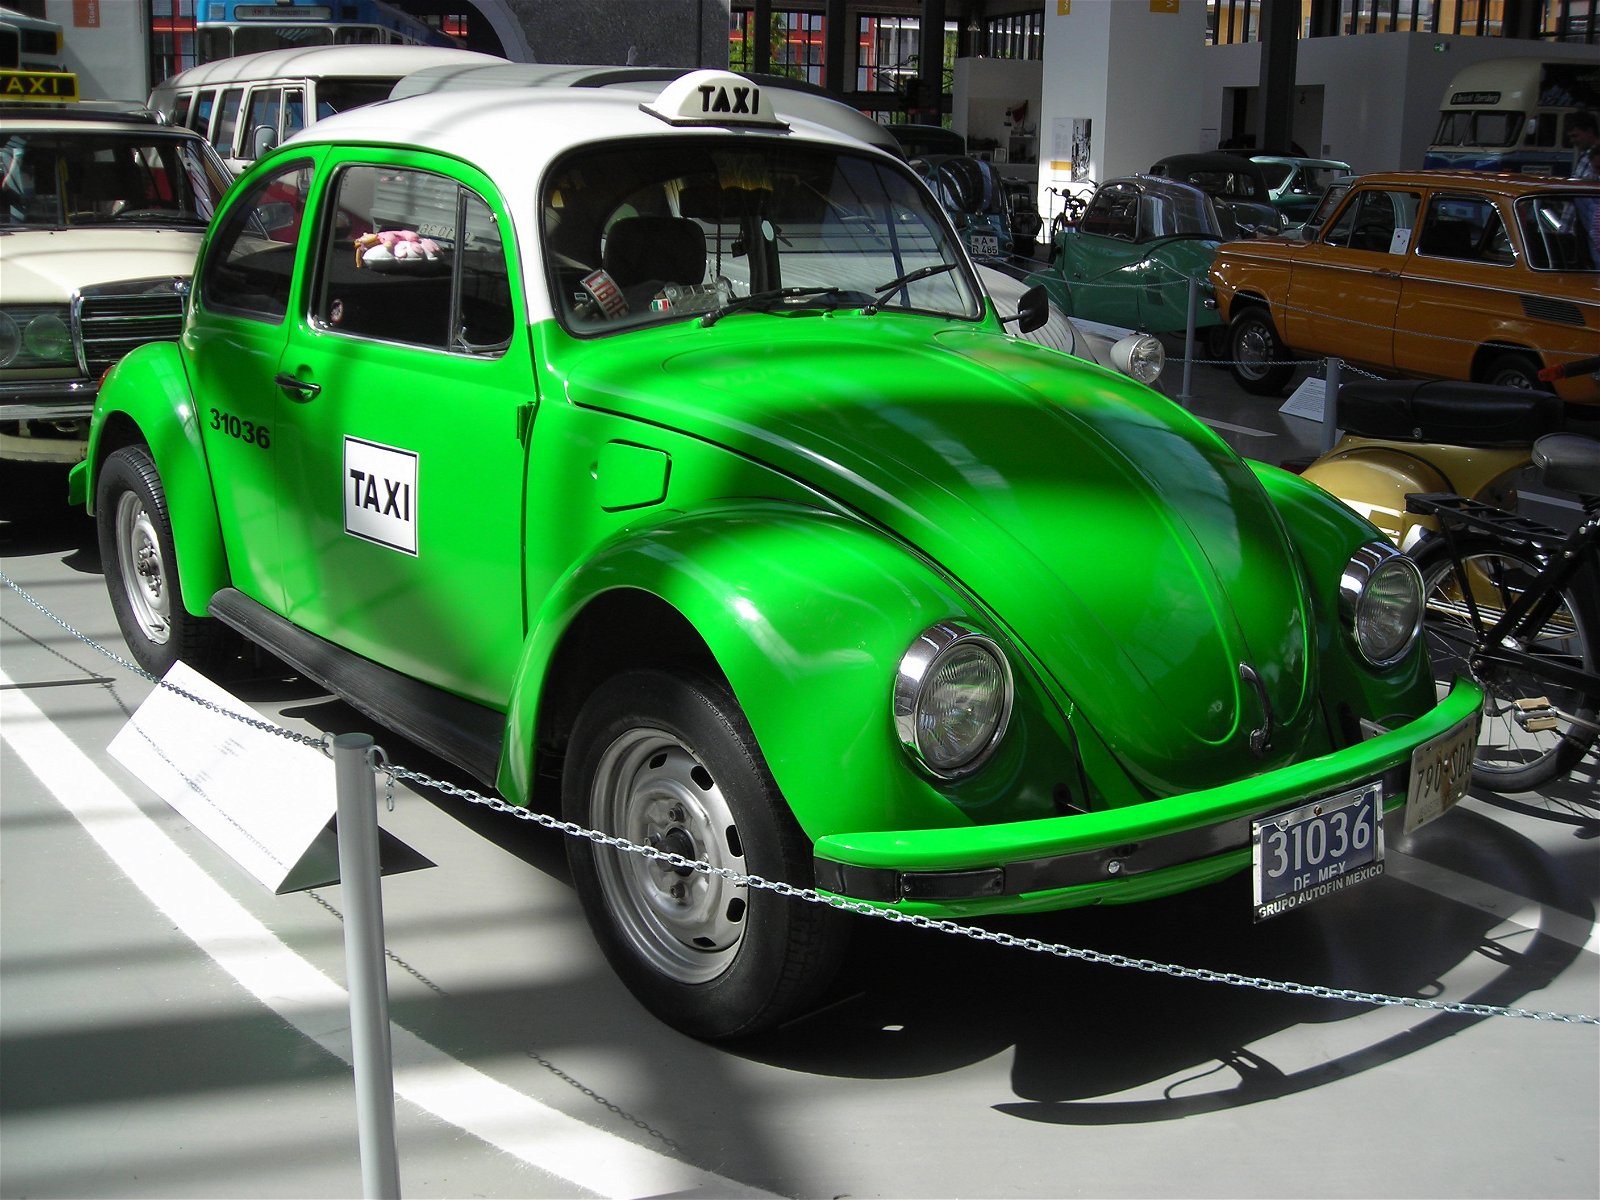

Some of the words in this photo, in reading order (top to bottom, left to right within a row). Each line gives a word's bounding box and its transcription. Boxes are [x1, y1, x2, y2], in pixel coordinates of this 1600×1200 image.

[0, 77, 58, 94] AXI
[698, 84, 760, 115] TAXI
[981, 237, 988, 245] A
[209, 408, 271, 449] 31036
[350, 468, 410, 522] TAXI
[1267, 804, 1371, 878] 31036
[1258, 896, 1297, 918] GRUPO
[1298, 880, 1344, 904] AUTOFIN
[1345, 863, 1384, 887] MEXICO
